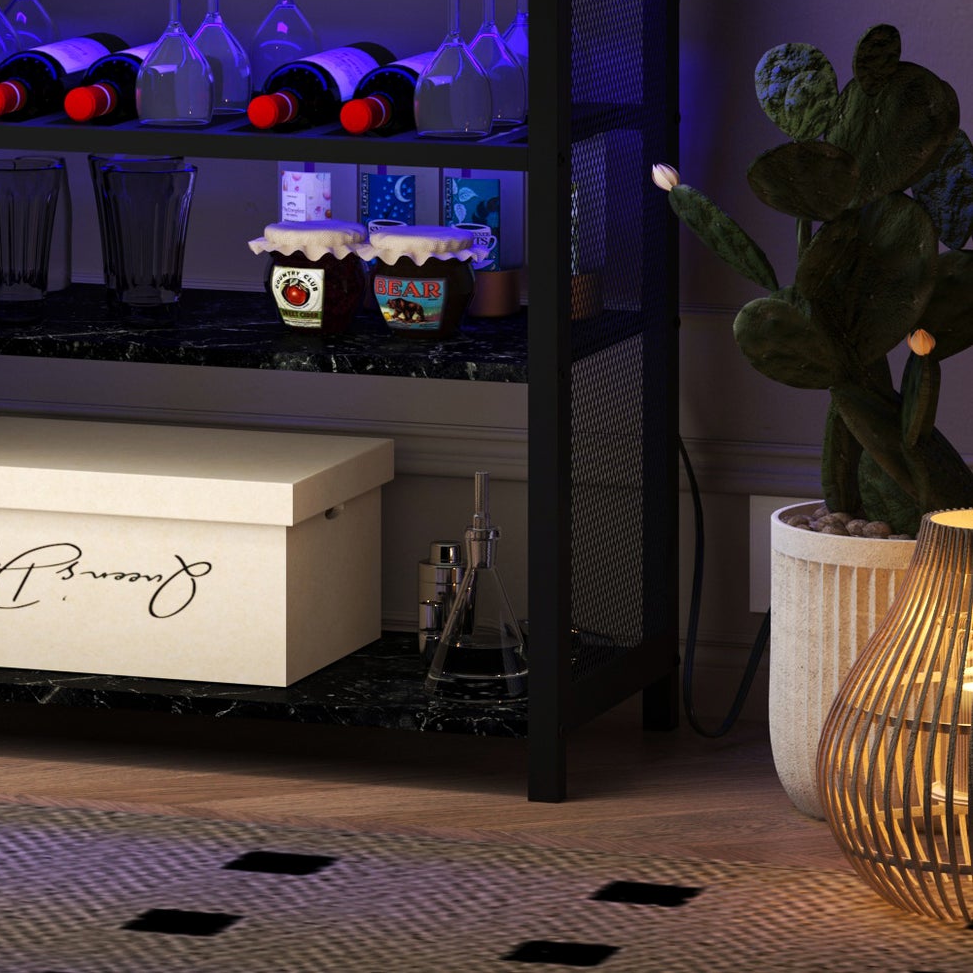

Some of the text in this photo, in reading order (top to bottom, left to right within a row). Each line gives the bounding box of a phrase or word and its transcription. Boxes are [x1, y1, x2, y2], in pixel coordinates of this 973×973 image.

[275, 271, 319, 292] COUNTRY CLUB
[375, 278, 441, 298] BEAR
[55, 554, 212, 618] Queen's
